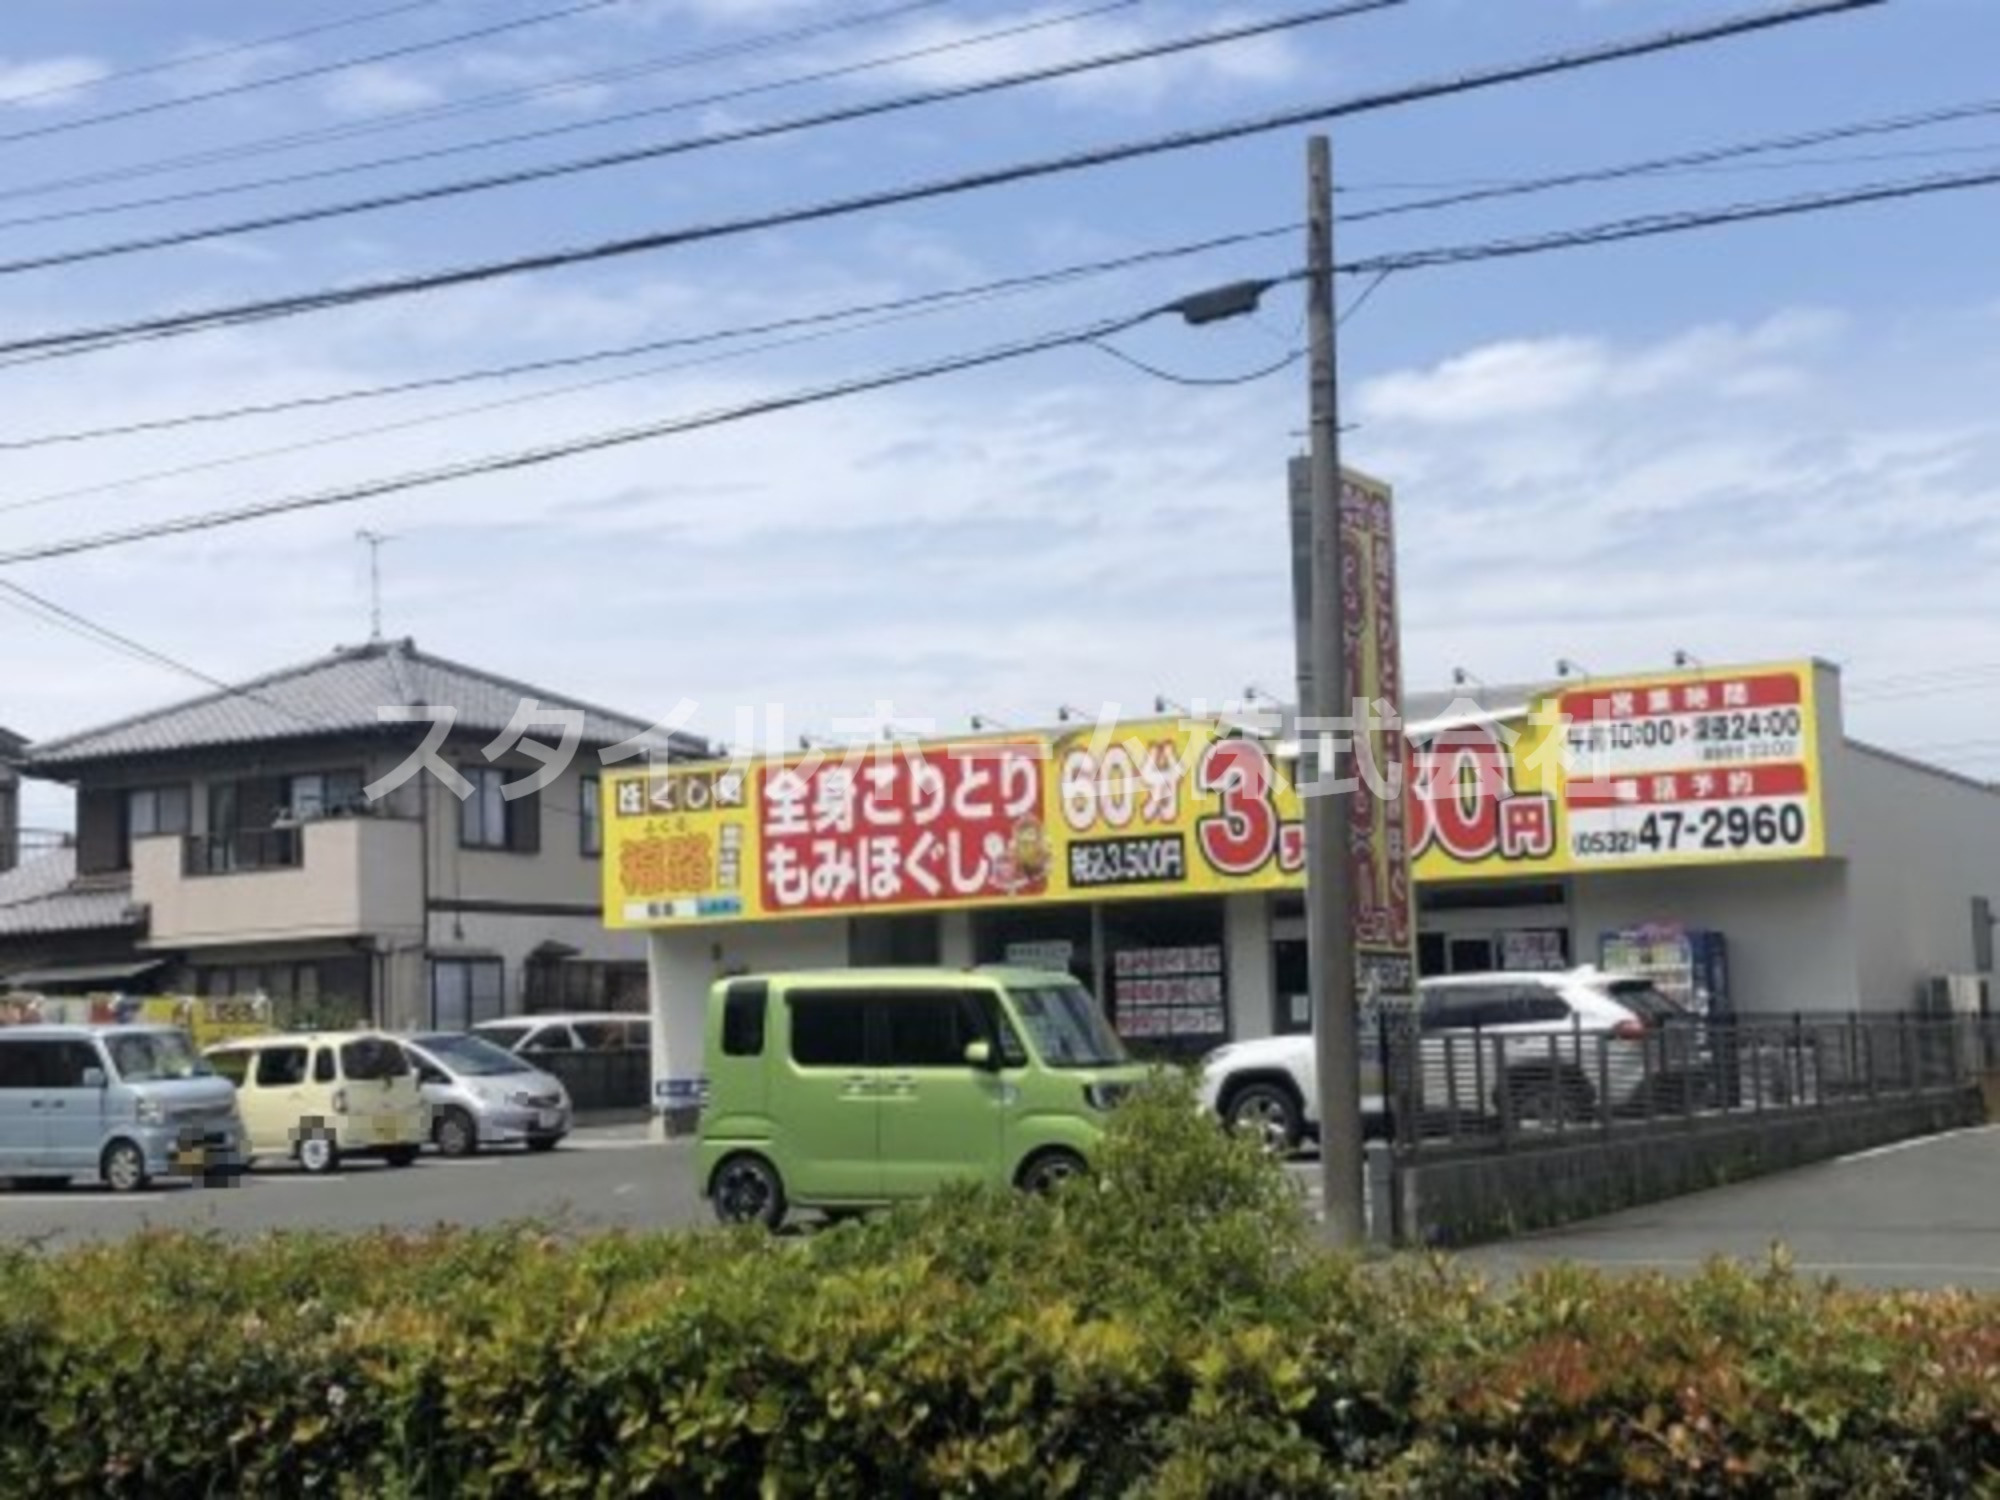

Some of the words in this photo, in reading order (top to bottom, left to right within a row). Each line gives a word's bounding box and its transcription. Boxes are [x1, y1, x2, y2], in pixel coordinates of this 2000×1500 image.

[763, 751, 1039, 836] 全身こりとり
[1060, 739, 1187, 831] 60分
[767, 829, 989, 905] もみほぐし
